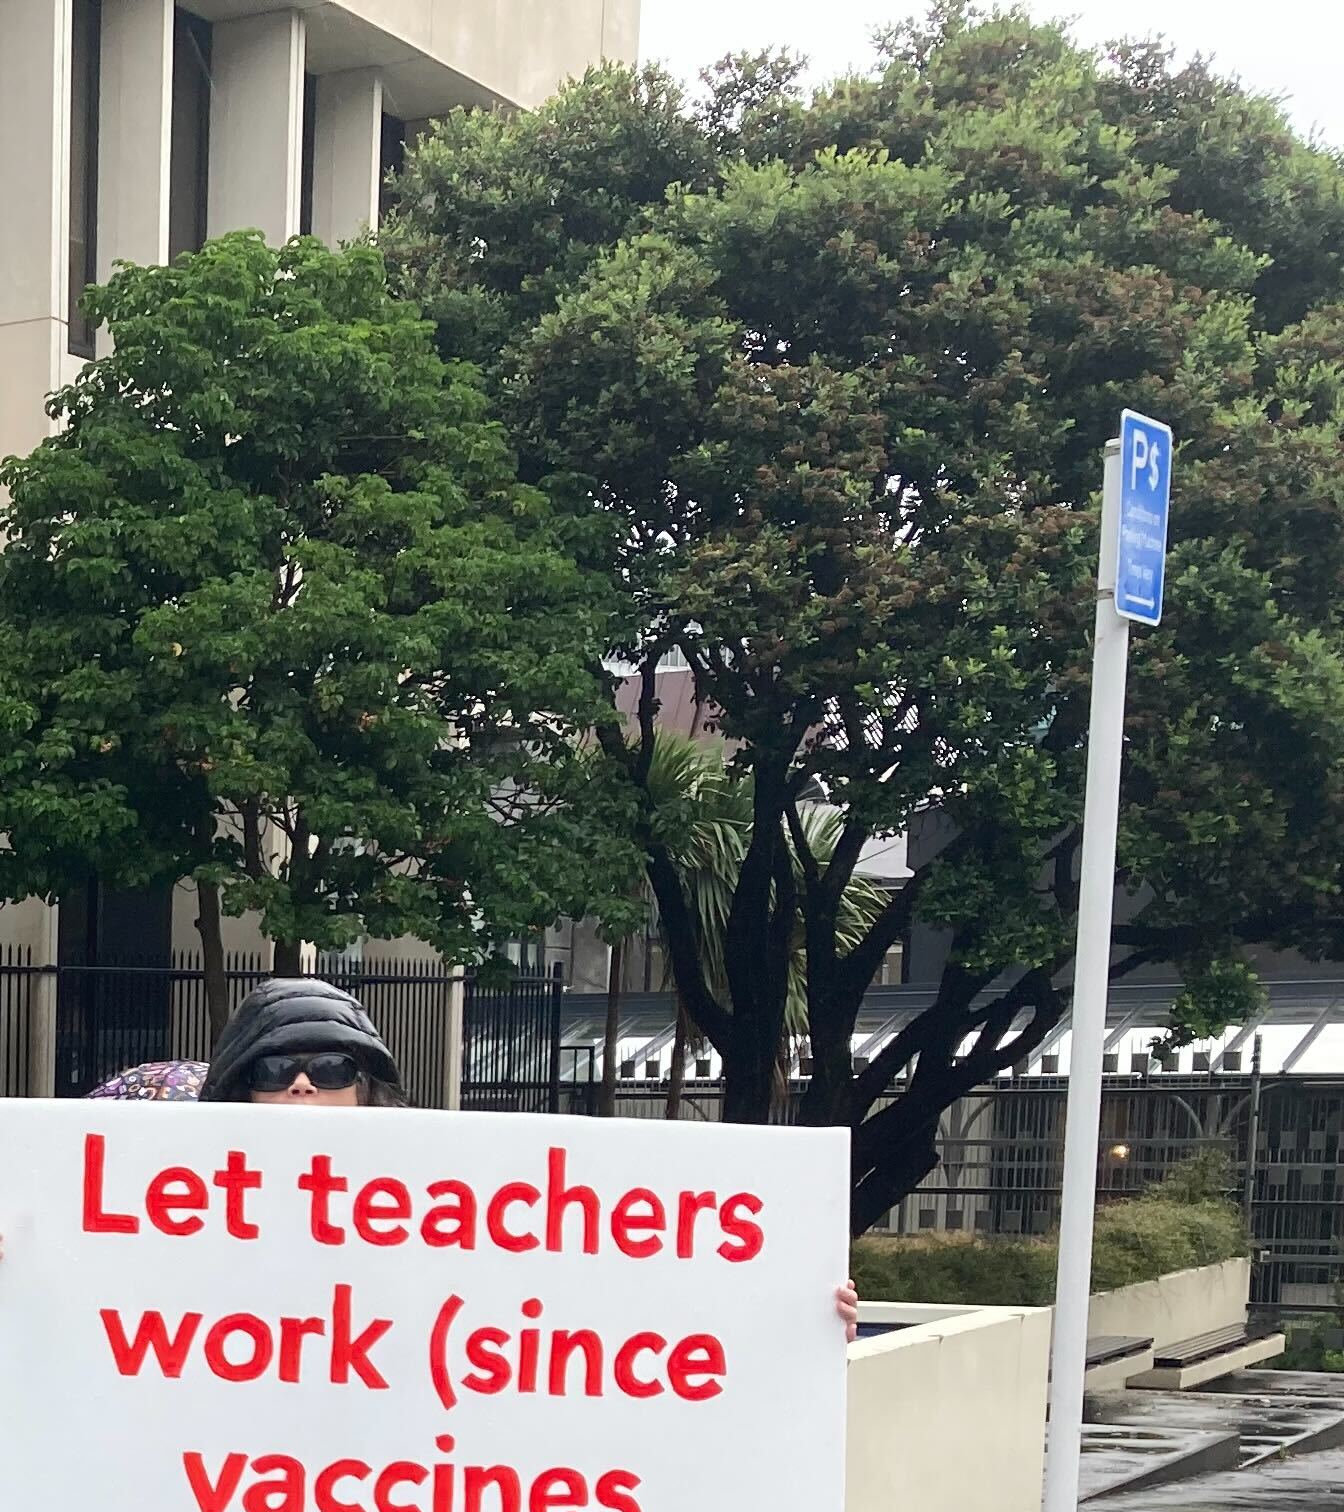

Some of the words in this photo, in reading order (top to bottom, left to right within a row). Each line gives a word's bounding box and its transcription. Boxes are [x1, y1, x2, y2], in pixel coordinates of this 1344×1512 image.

[83, 1134, 261, 1239] Let
[298, 1148, 763, 1262] teachers
[100, 1284, 392, 1389] work
[430, 1295, 725, 1410] (since
